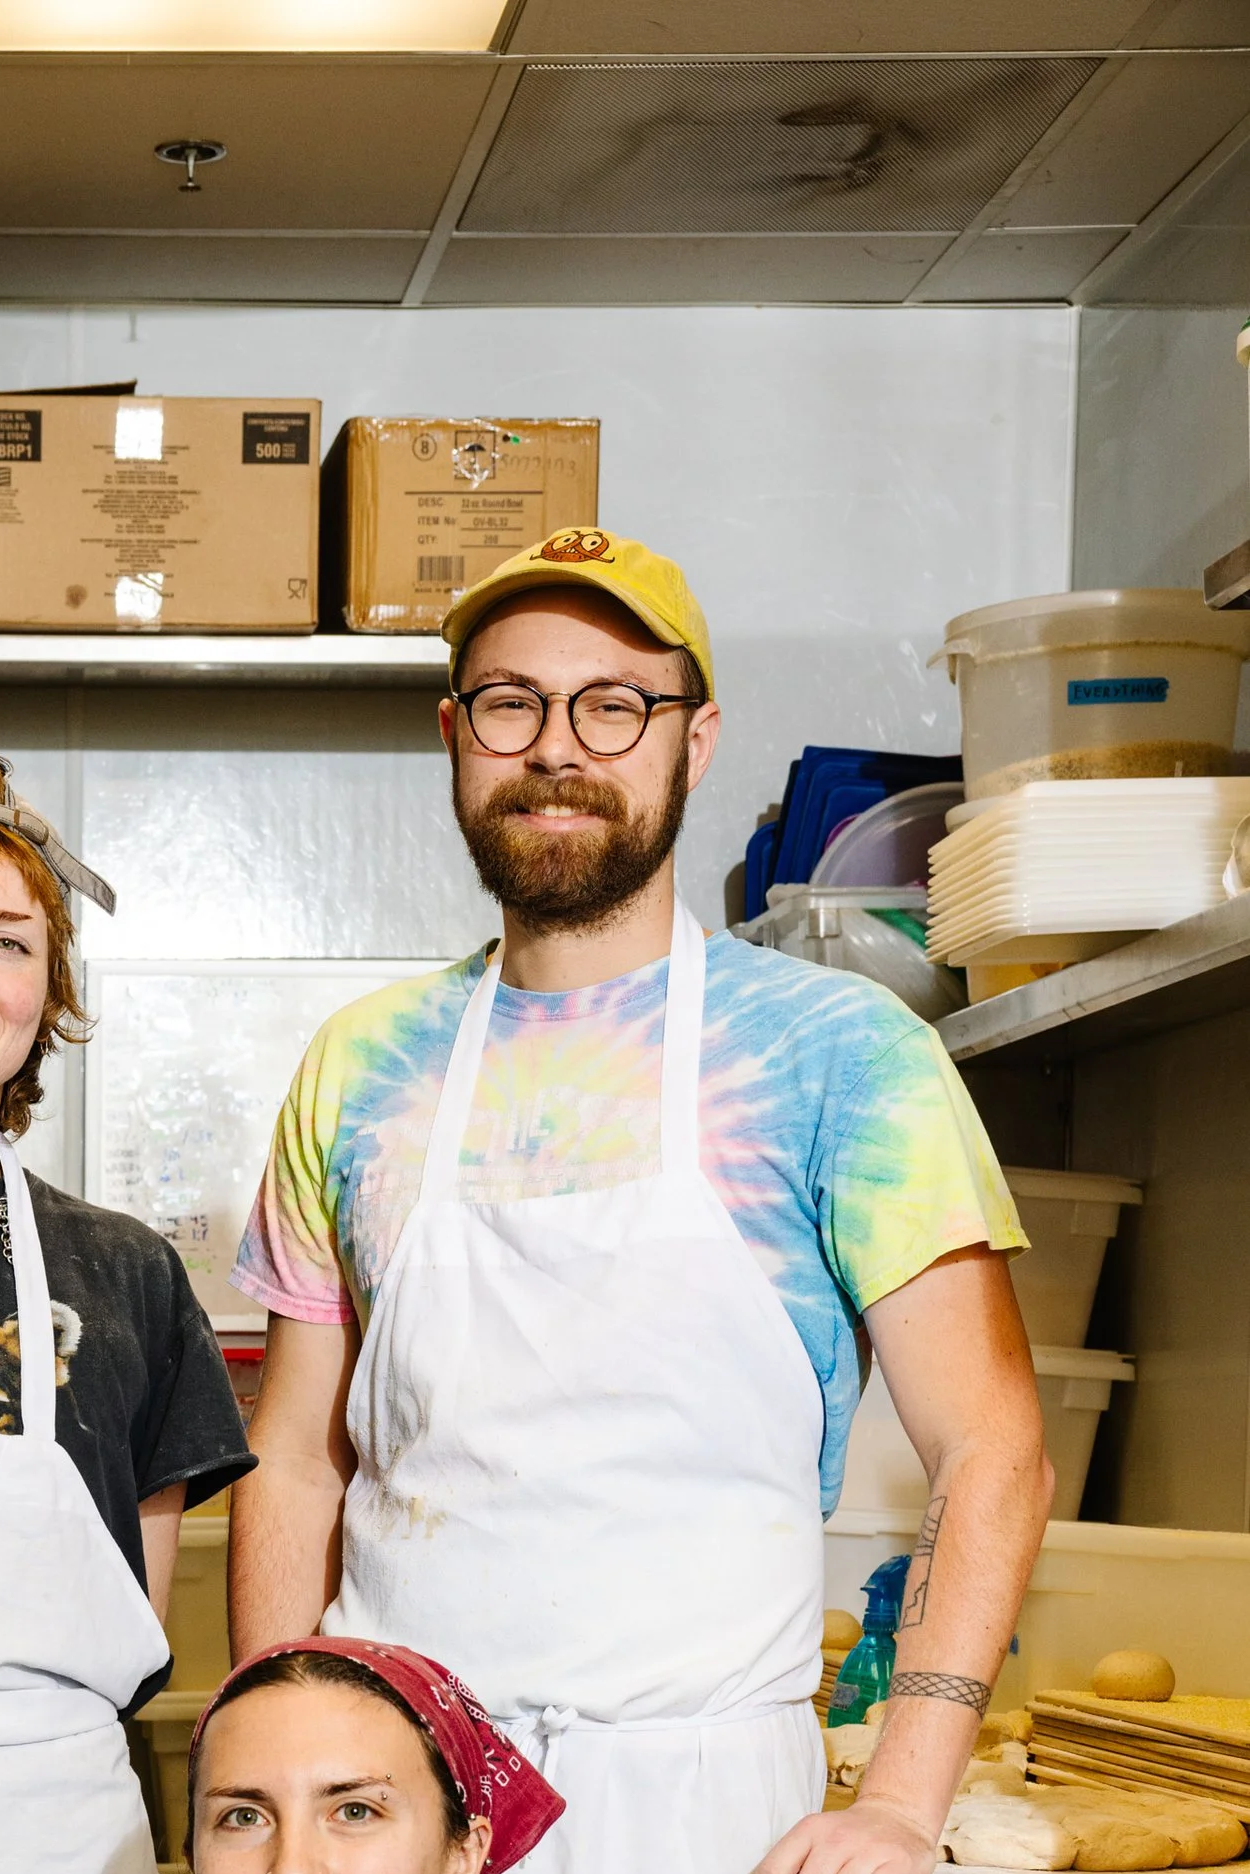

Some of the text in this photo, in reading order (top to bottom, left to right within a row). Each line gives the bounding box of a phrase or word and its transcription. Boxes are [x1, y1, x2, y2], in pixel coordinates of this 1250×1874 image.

[256, 443, 281, 458] 500
[420, 440, 430, 454] 8
[1073, 681, 1167, 700] EVERYTHING
